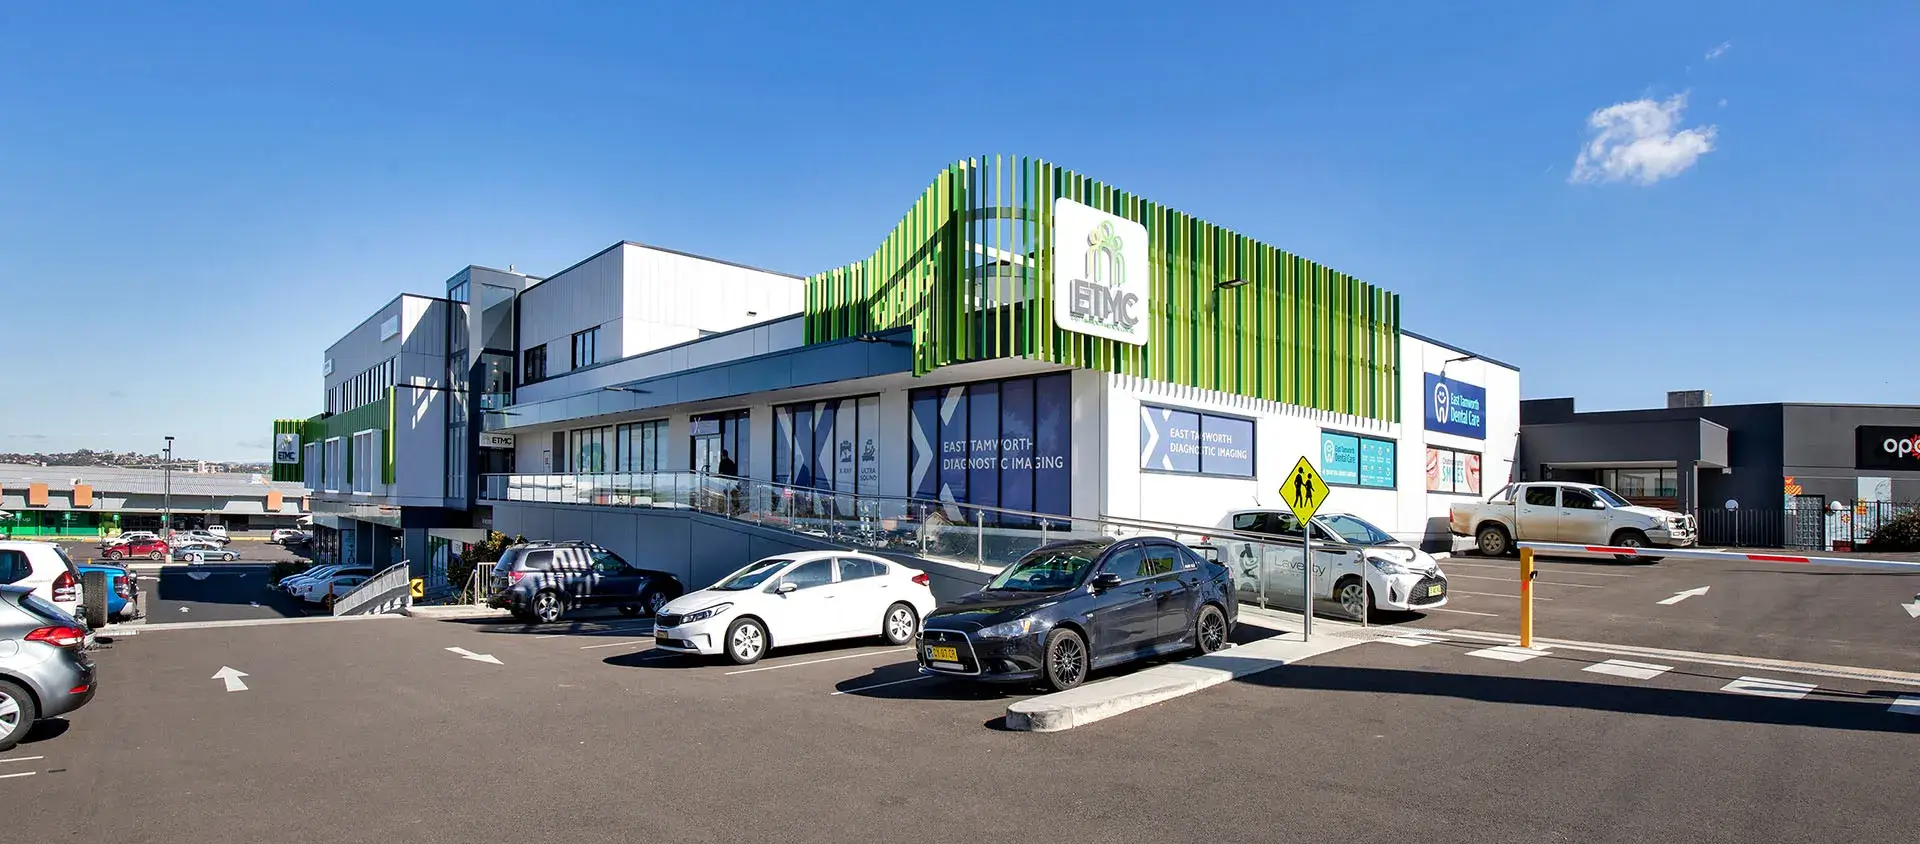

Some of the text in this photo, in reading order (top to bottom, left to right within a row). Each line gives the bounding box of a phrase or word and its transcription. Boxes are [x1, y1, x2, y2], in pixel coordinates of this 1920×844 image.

[1070, 279, 1139, 329] ETMC
[1450, 393, 1479, 410] East Tamworth
[1450, 406, 1480, 427] Dental Care
[492, 436, 512, 445] ETMC
[1170, 428, 1189, 440] EAST
[943, 438, 1033, 453] EAST TAMWORTH
[278, 451, 296, 460] ETMC
[1217, 447, 1247, 460] IMAGING
[1335, 452, 1346, 463] Dental
[1347, 454, 1356, 464] Care
[943, 456, 1063, 470] DIAGNOSTC IMAGING
[1442, 465, 1464, 483] SMES
[1275, 555, 1326, 577] Lavety
